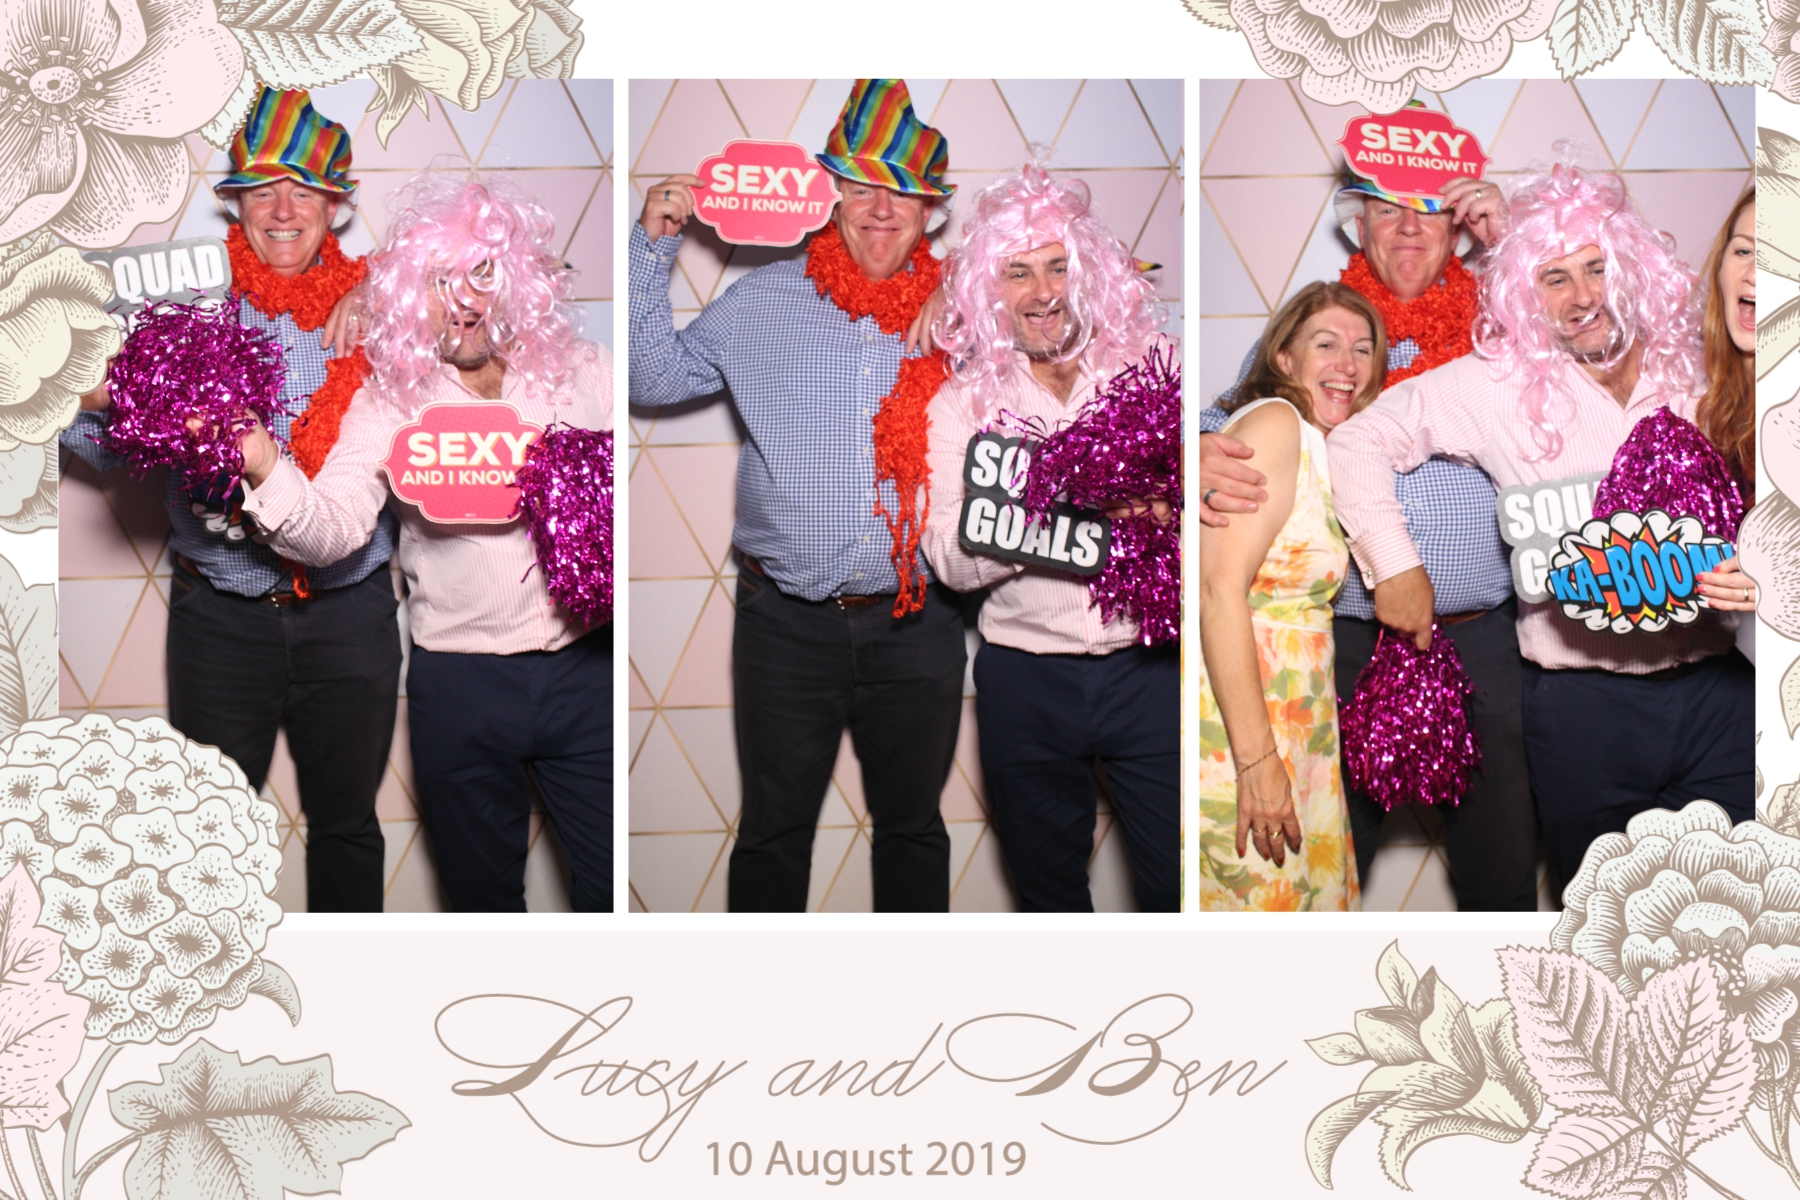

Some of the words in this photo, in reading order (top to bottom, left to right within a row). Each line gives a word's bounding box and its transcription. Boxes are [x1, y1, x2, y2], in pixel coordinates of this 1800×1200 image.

[1360, 122, 1468, 158] SEXY
[710, 163, 819, 197] SEXY
[1356, 150, 1395, 165] AND
[1398, 154, 1403, 166] I
[1407, 155, 1460, 172] KNOW
[1463, 162, 1478, 174] IT
[702, 195, 740, 210] AND
[743, 197, 748, 211] I
[752, 198, 805, 214] KNOW
[808, 201, 824, 215] IT
[90, 245, 225, 304] QUAD
[407, 431, 536, 467] SEXY
[401, 470, 444, 485] AND
[448, 470, 454, 485] I
[1504, 482, 1600, 539] SQU
[966, 498, 1102, 568] GOALS
[1549, 539, 1734, 607] KA-BOOM
